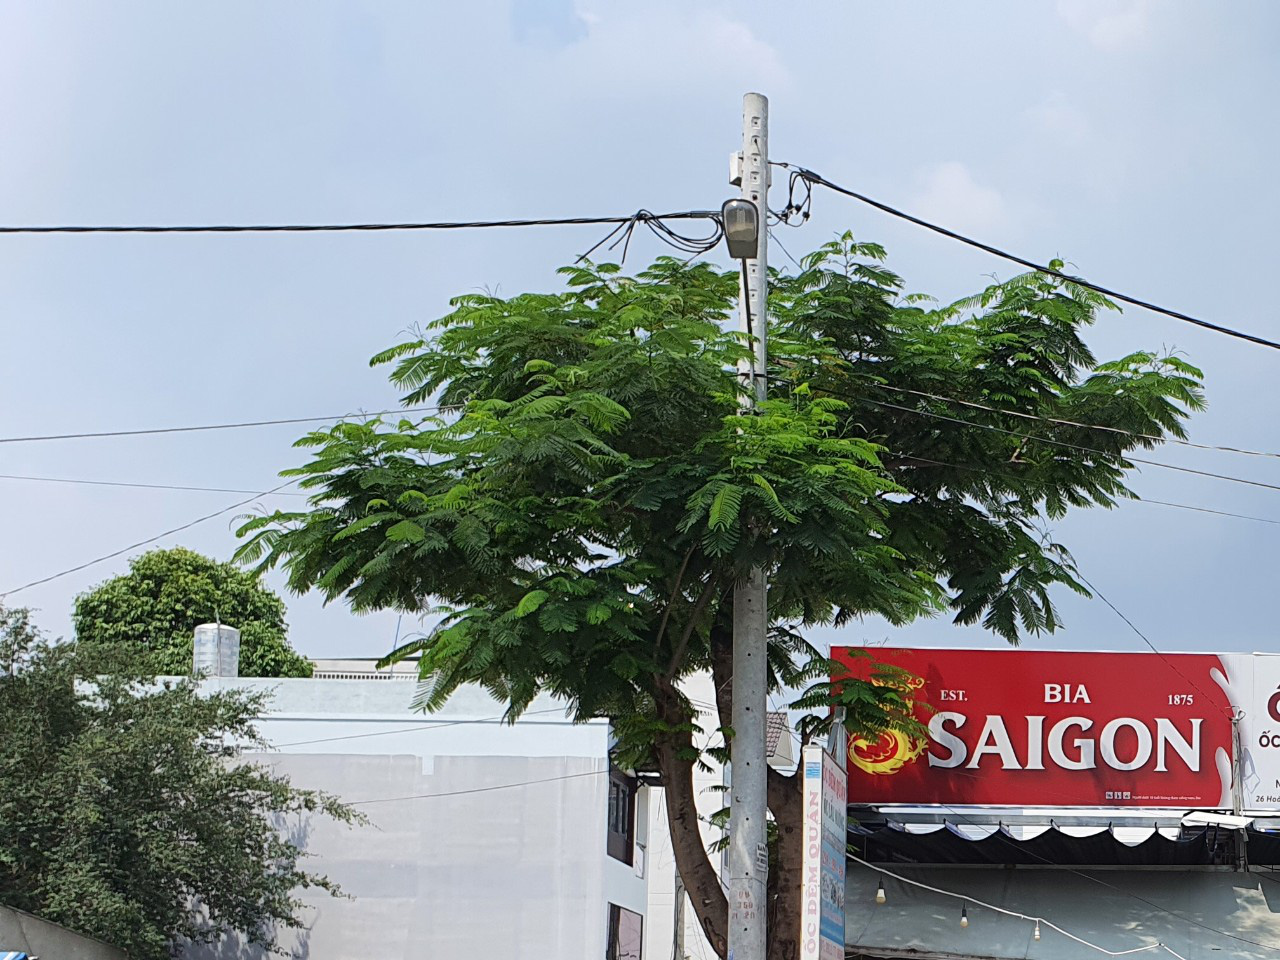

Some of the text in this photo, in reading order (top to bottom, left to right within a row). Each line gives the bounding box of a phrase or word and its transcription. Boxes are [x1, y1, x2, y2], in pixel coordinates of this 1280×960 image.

[940, 690, 968, 701] EST.
[1044, 683, 1091, 704] BIA
[1168, 694, 1193, 705] 1875
[927, 711, 1204, 772] SAIGON
[1258, 730, 1280, 748] ỐC
[1256, 795, 1265, 803] 26
